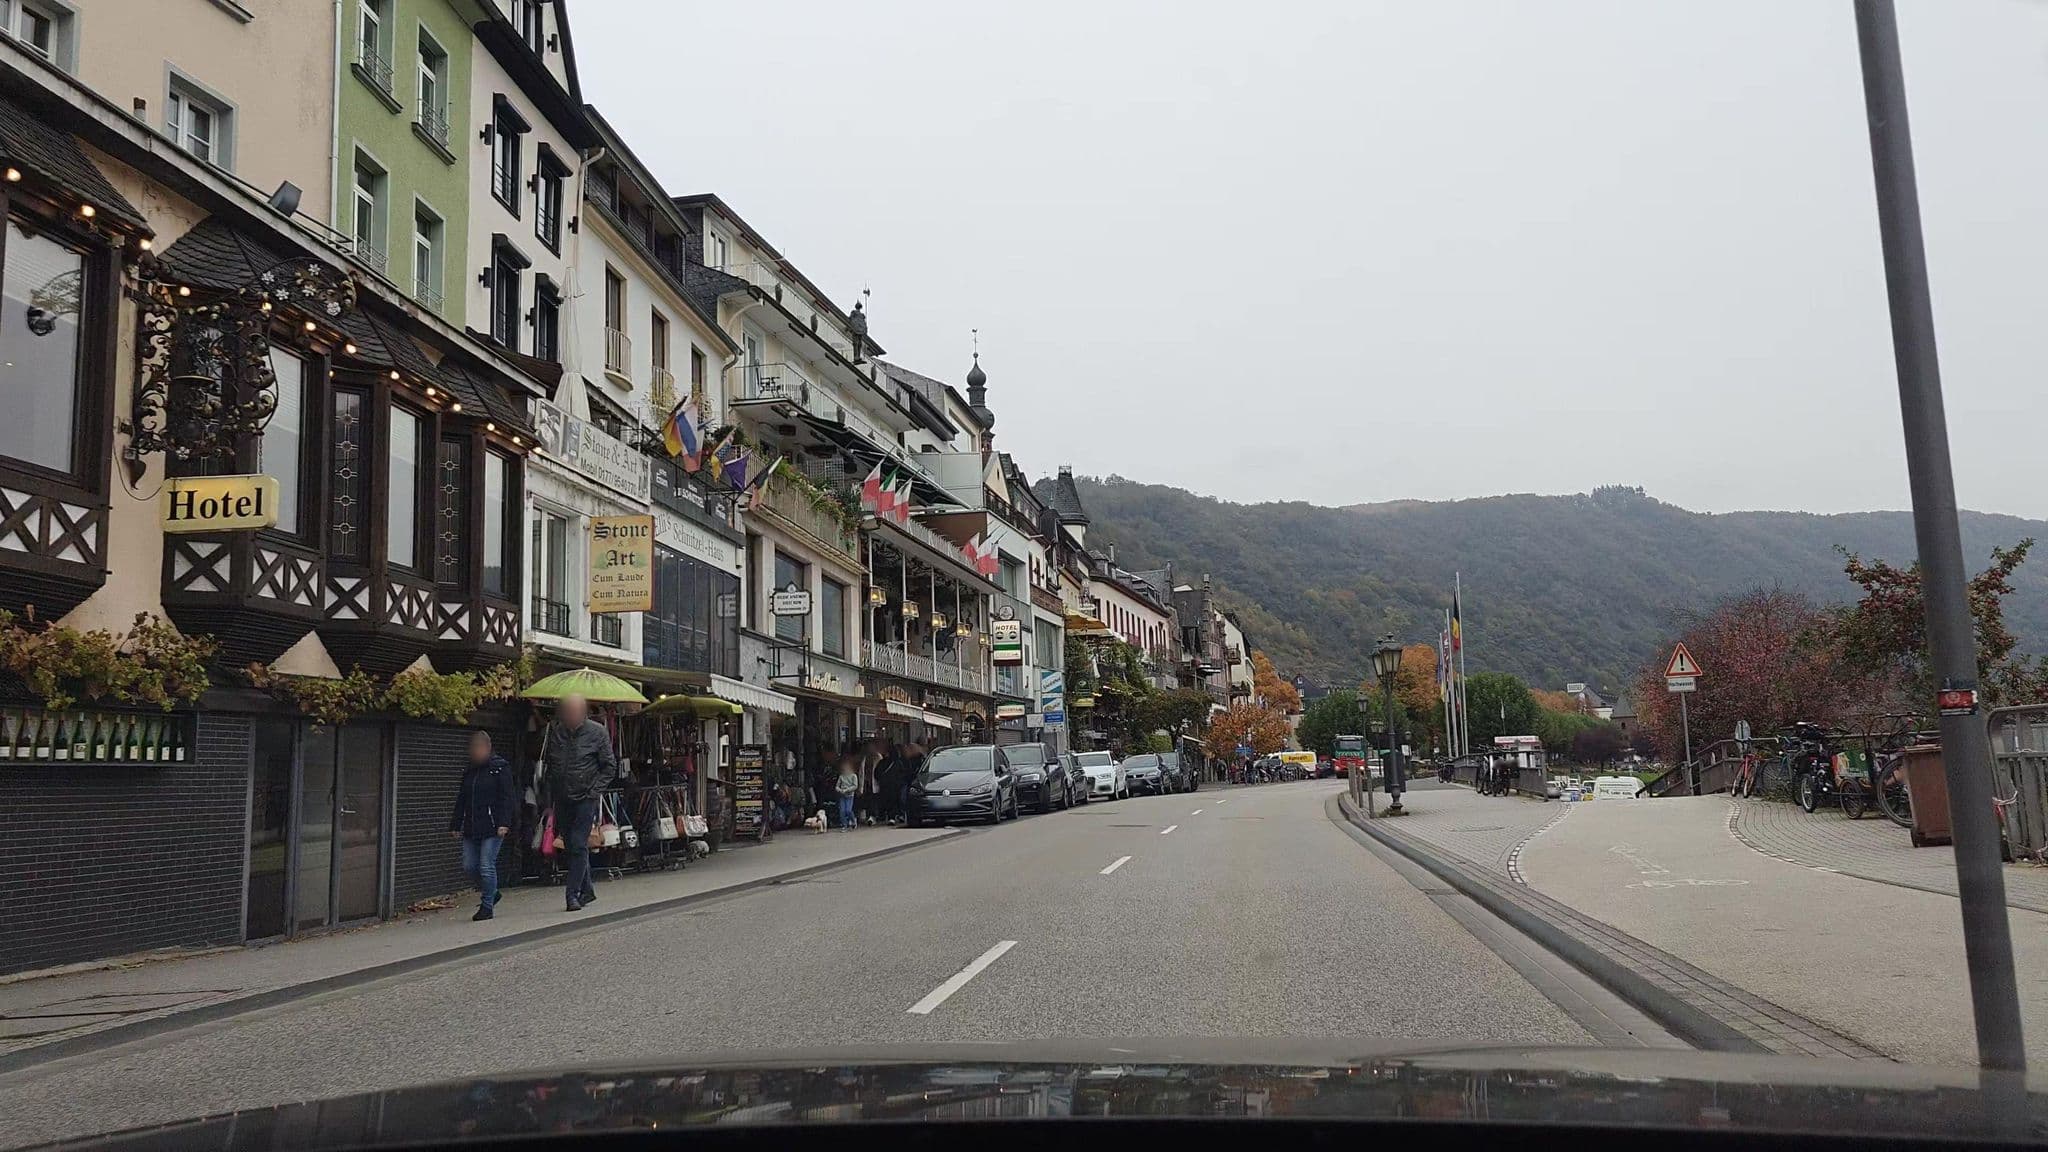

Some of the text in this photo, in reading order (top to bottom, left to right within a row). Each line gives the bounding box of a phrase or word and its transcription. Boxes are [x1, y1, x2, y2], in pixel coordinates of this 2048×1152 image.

[581, 427, 610, 460] Stone
[611, 443, 620, 466] &
[622, 448, 637, 474] Art
[166, 487, 263, 521] Hotel
[593, 522, 648, 540] Stone
[606, 549, 635, 567] Art
[592, 573, 644, 582] Cum Laude
[592, 589, 649, 599] Cum Natura
